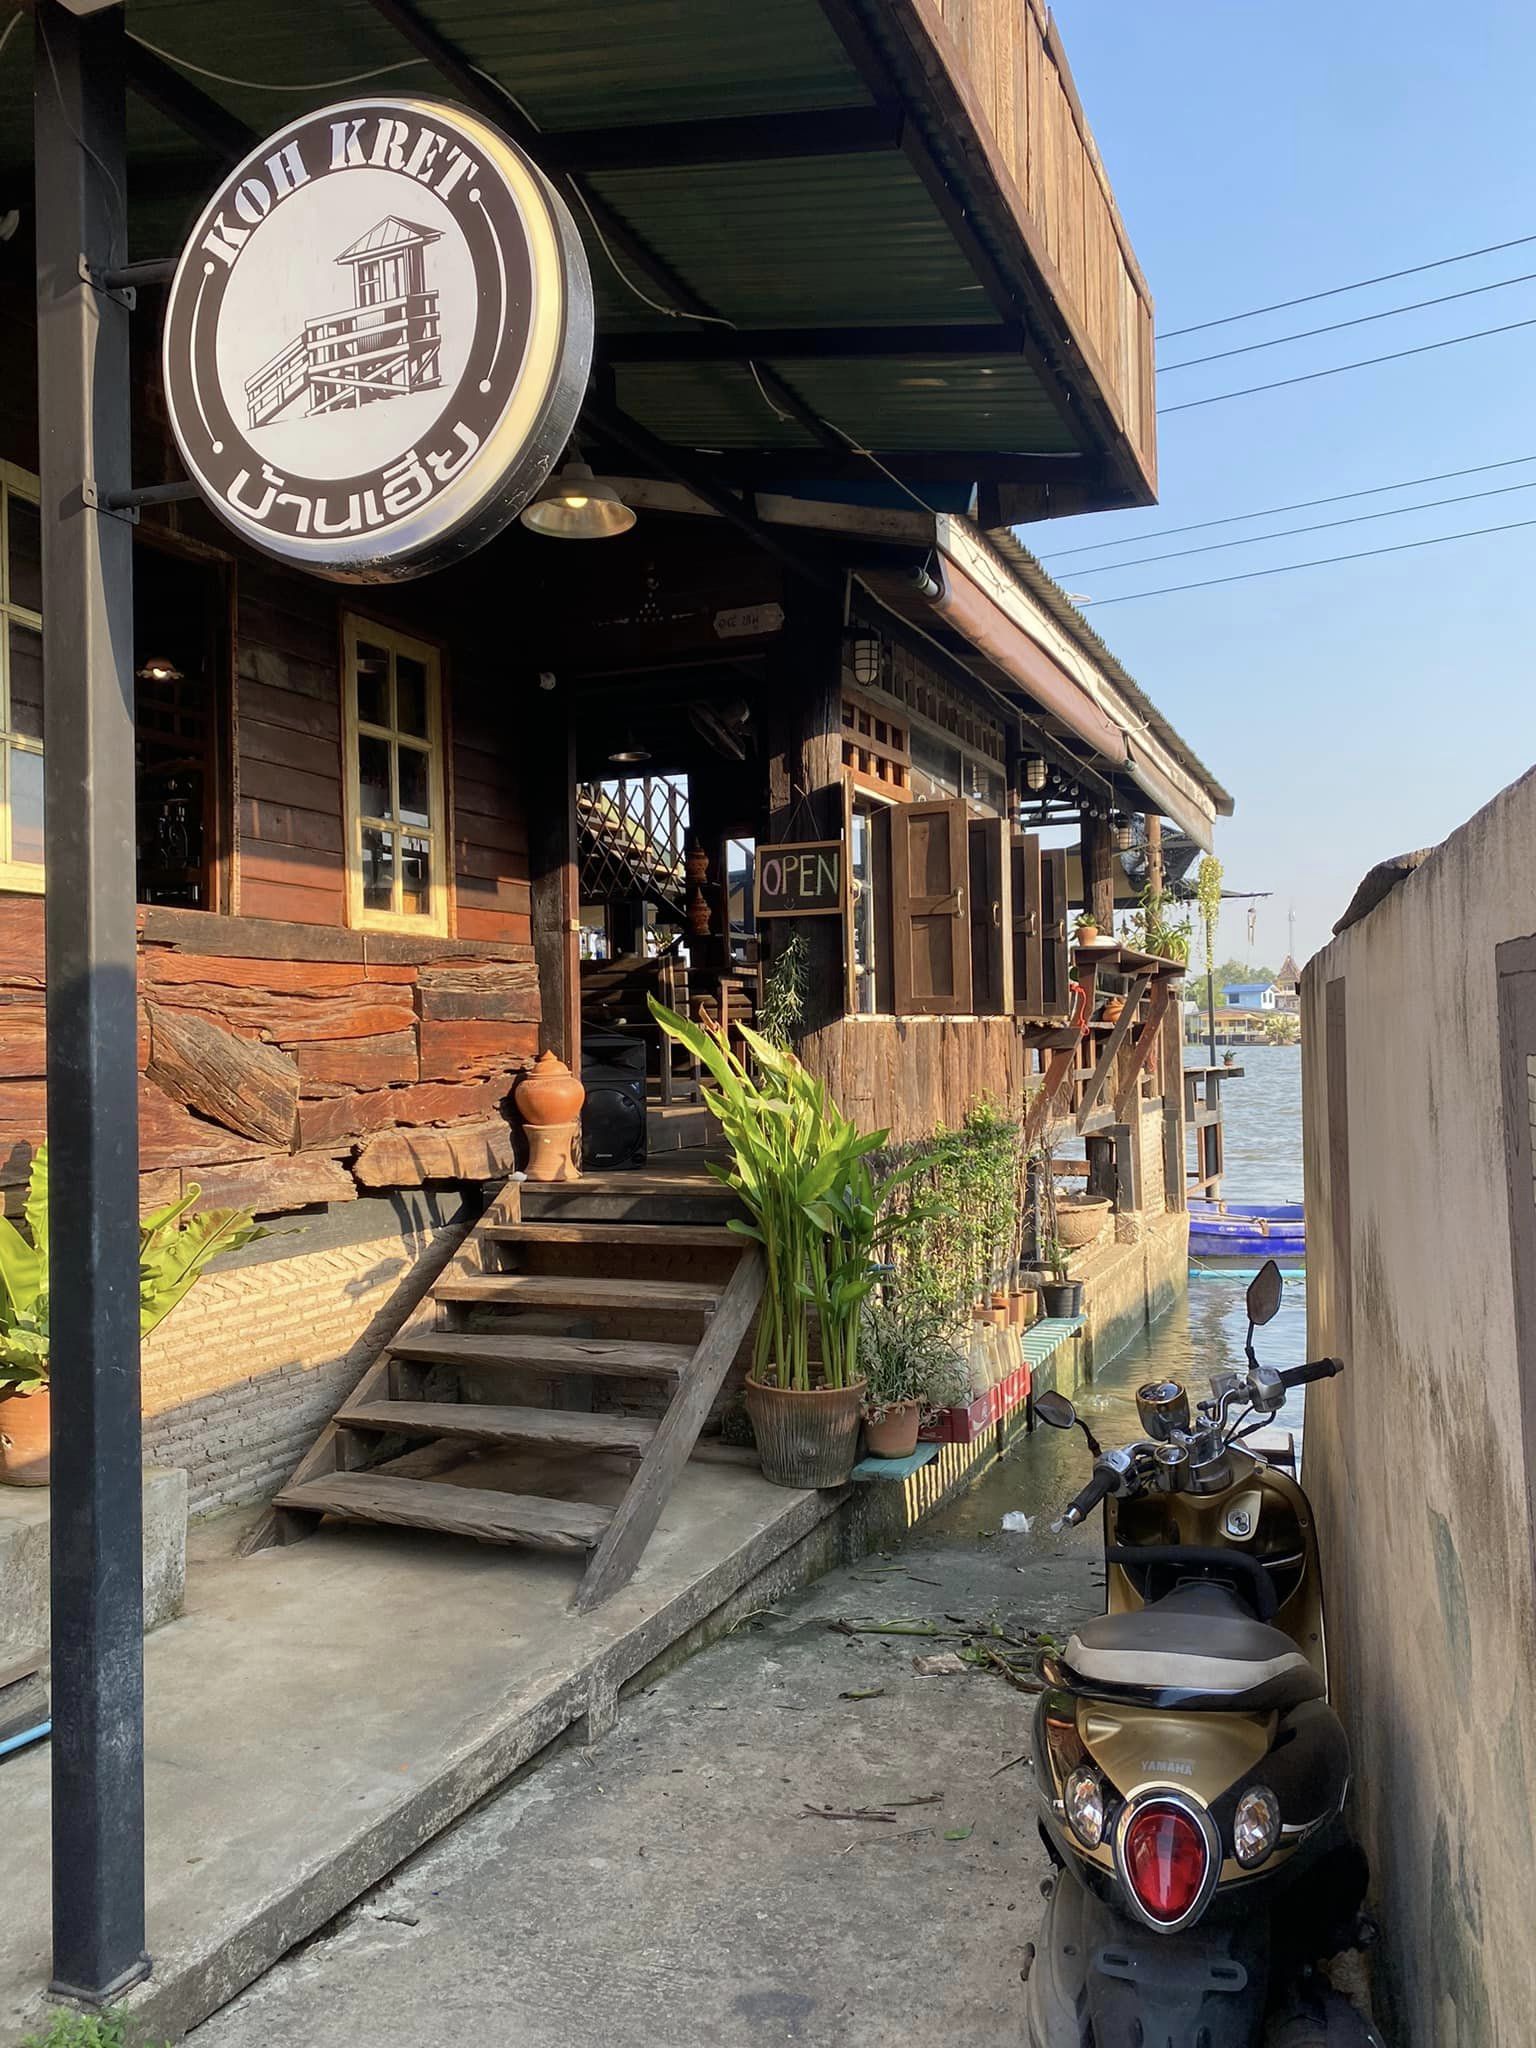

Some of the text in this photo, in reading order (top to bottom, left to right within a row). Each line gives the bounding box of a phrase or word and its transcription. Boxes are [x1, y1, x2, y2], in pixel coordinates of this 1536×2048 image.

[202, 118, 479, 268] KOH KRET
[762, 853, 838, 897] OPEN
[1141, 1760, 1193, 1776] YAMAHA
